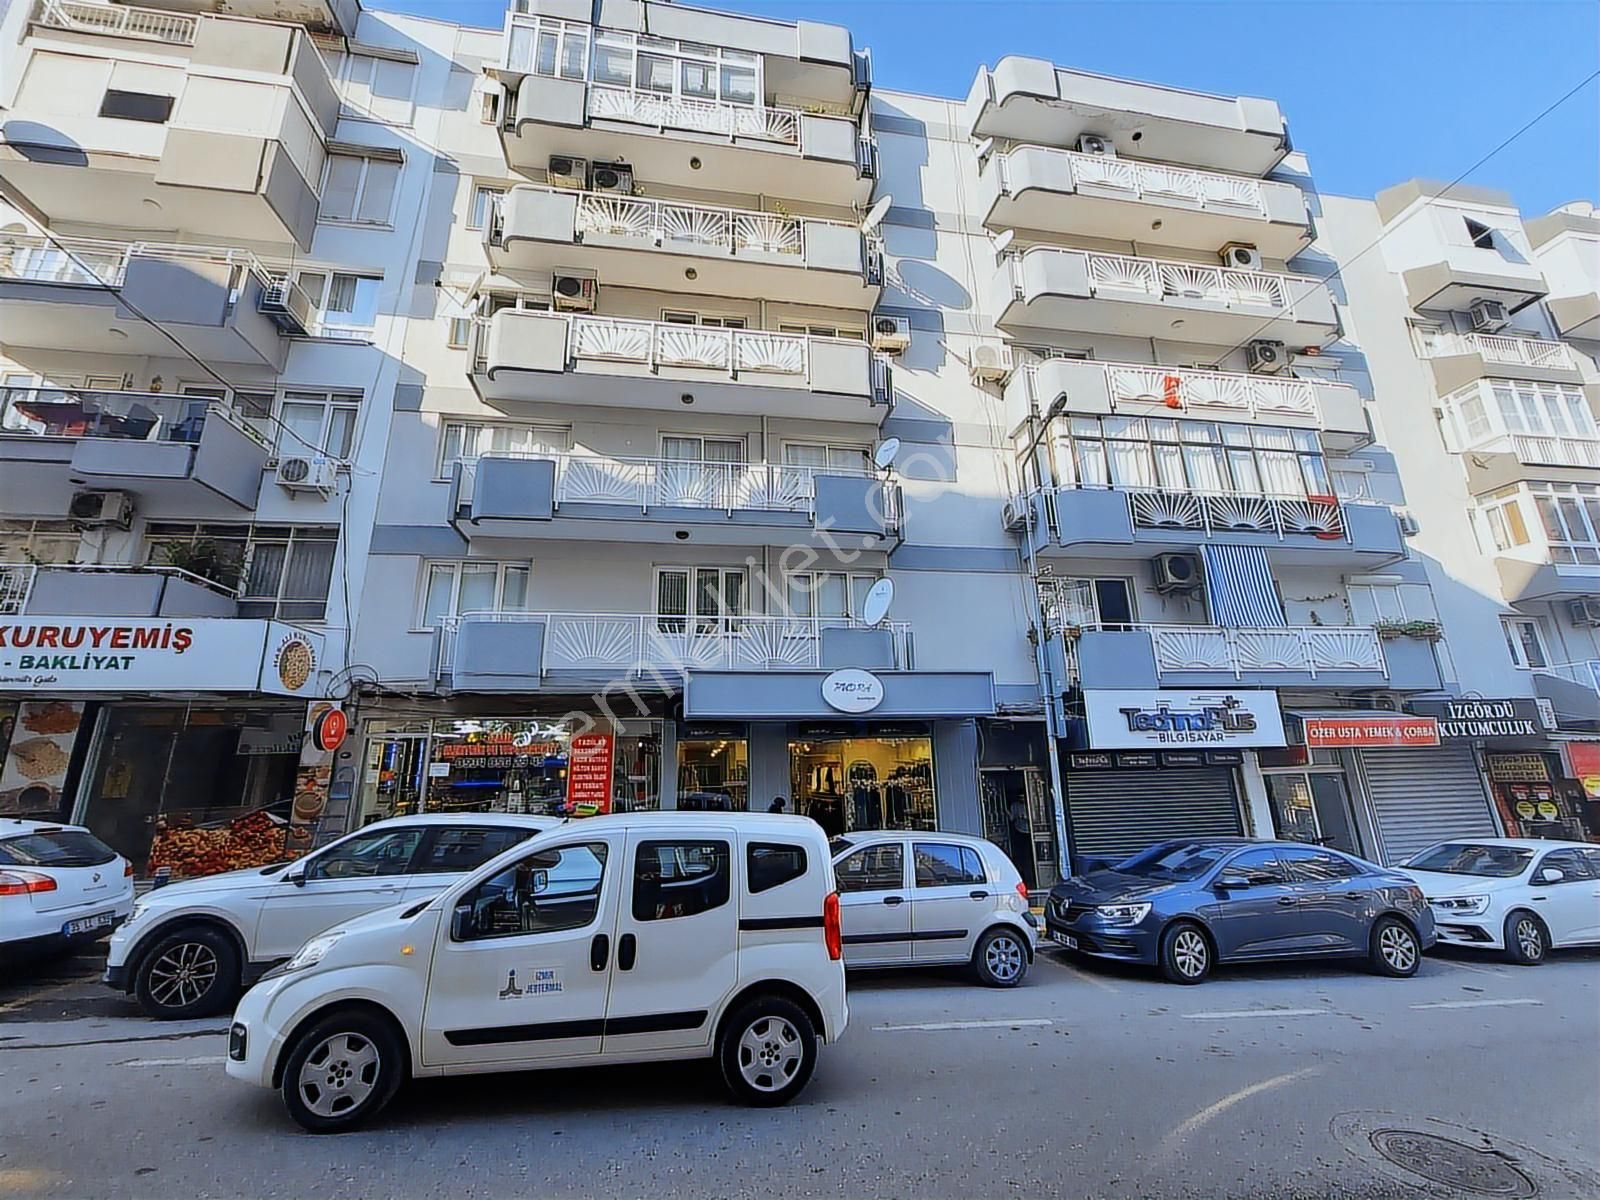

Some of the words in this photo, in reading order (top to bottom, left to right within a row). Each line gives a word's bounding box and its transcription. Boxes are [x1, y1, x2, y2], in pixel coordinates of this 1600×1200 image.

[19, 652, 135, 670] BAKLİYAT
[1119, 706, 1257, 732] TechnoPlus
[1449, 702, 1514, 720] İZGÖRDÜ
[1310, 725, 1335, 738] ÖZER
[1338, 727, 1361, 738] USTA
[1363, 726, 1393, 738] YEMEK
[1403, 727, 1435, 738] ÇORBA
[1440, 720, 1537, 738] KUYUMCULUK
